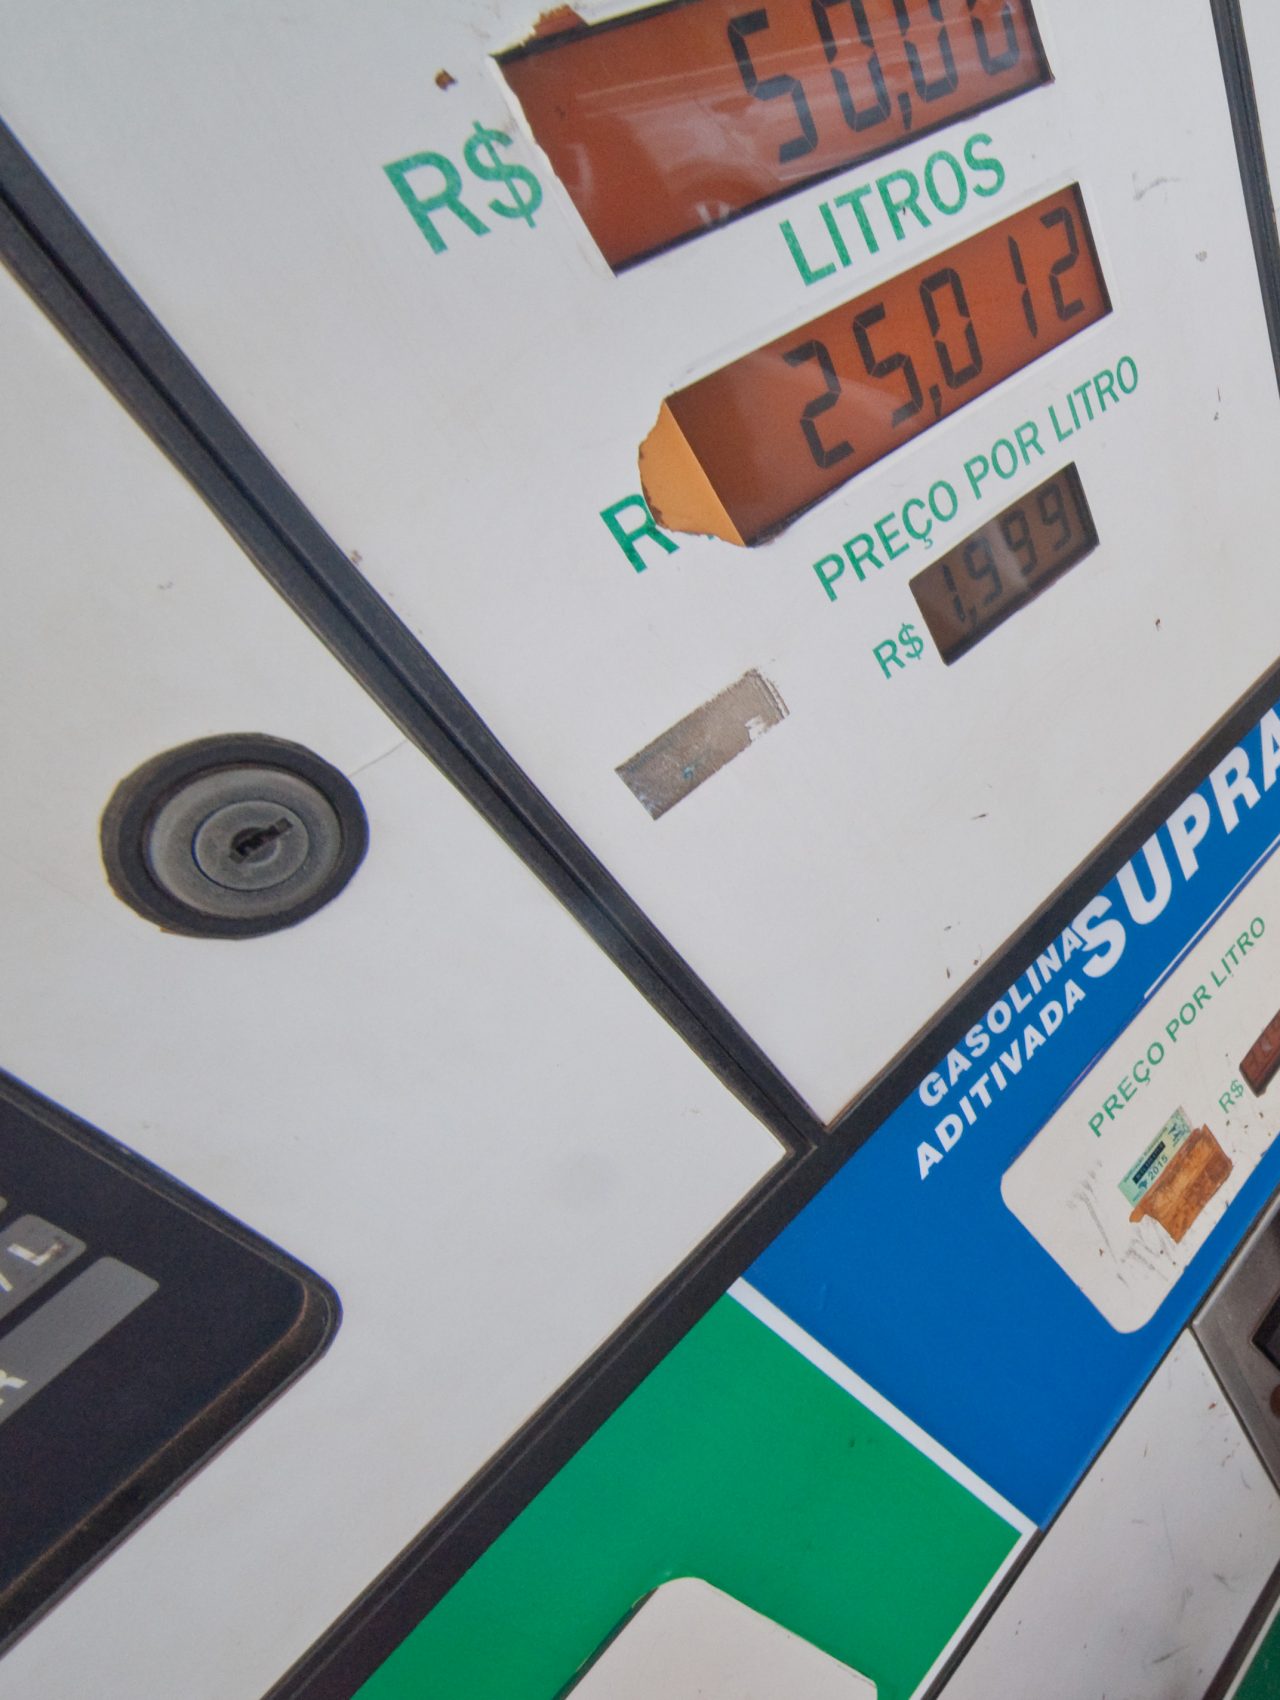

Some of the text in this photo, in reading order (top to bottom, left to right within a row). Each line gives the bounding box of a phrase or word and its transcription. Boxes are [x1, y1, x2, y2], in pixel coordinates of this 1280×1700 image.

[382, 121, 544, 255] R$
[779, 133, 1006, 288] LITROS
[600, 494, 681, 574] R
[812, 355, 1140, 602] PREÇO POR LITRO
[872, 622, 925, 680] R$
[916, 978, 1087, 1181] ADITIVADA
[918, 926, 1084, 1107] GASOLINA
[1087, 1041, 1165, 1138] PREÇO
[1164, 984, 1213, 1043] POR
[1210, 916, 1266, 988] LITRO
[1217, 1079, 1245, 1114] R$
